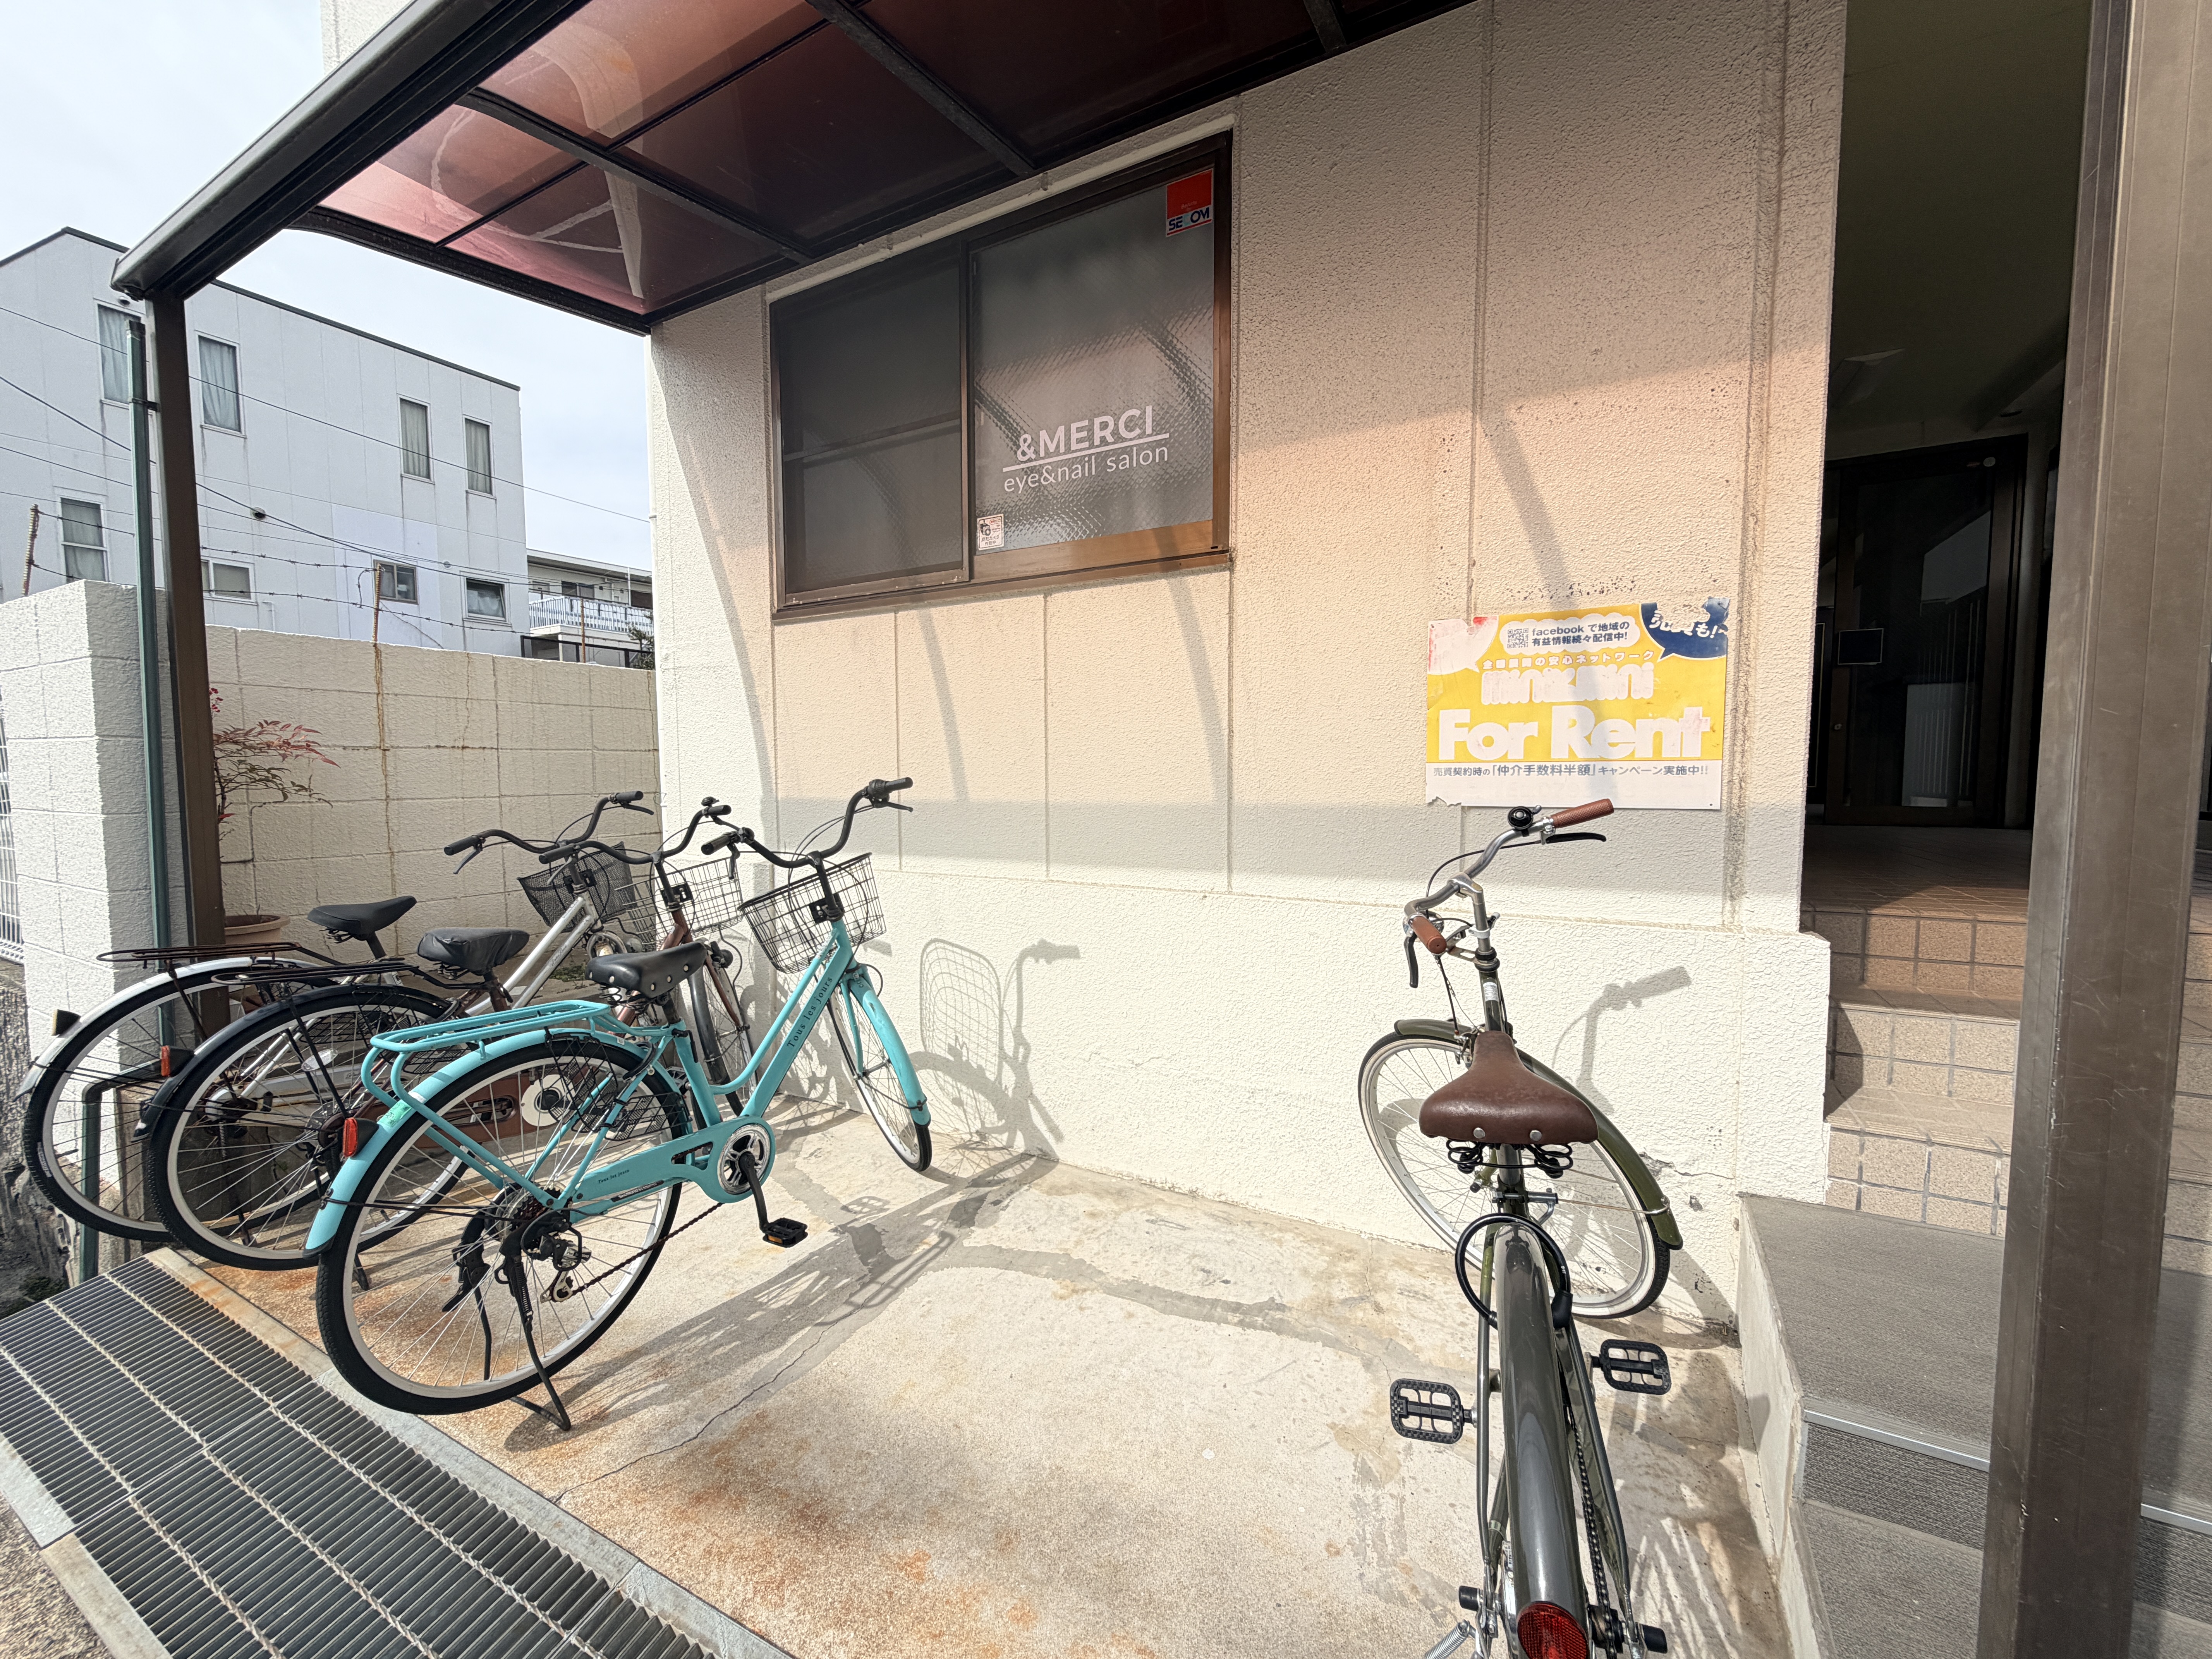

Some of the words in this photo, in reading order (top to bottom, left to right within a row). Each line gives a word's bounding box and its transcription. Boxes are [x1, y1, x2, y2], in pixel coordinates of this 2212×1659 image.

[1017, 405, 1152, 461] &MERCI
[1004, 455, 1095, 493] eye&nail
[1106, 446, 1168, 472] salon
[1531, 632, 1628, 647] 有益情報続々配信中!
[1532, 625, 1585, 637] facebook
[1587, 621, 1630, 633] で地域の
[1439, 709, 1538, 761] For
[1551, 705, 1711, 759] Rent
[787, 1024, 805, 1047] Tous
[803, 1005, 816, 1020] les
[814, 977, 833, 1004] jours
